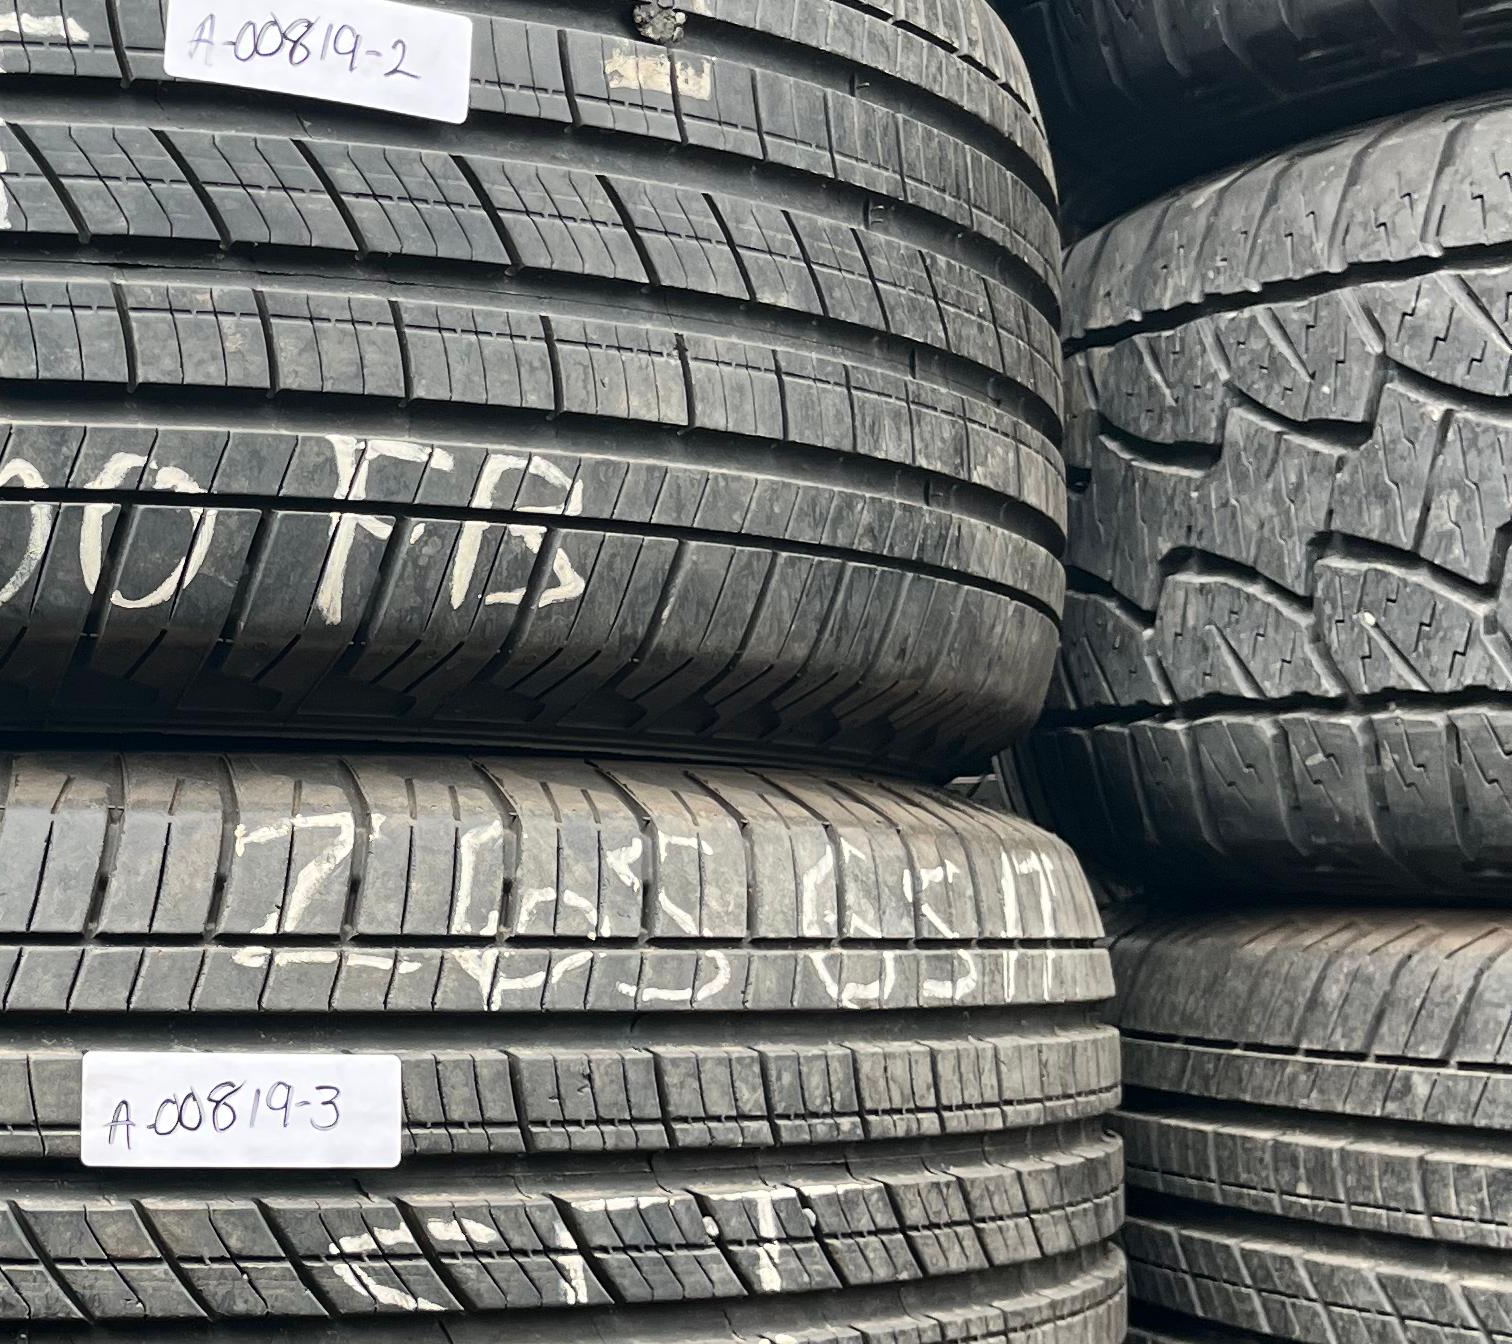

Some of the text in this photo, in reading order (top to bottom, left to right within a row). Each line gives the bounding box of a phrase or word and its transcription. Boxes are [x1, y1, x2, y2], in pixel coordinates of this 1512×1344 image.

[187, 11, 421, 80] A-00819-2
[314, 432, 588, 626] FB
[104, 1080, 342, 1150] A-00819-3
